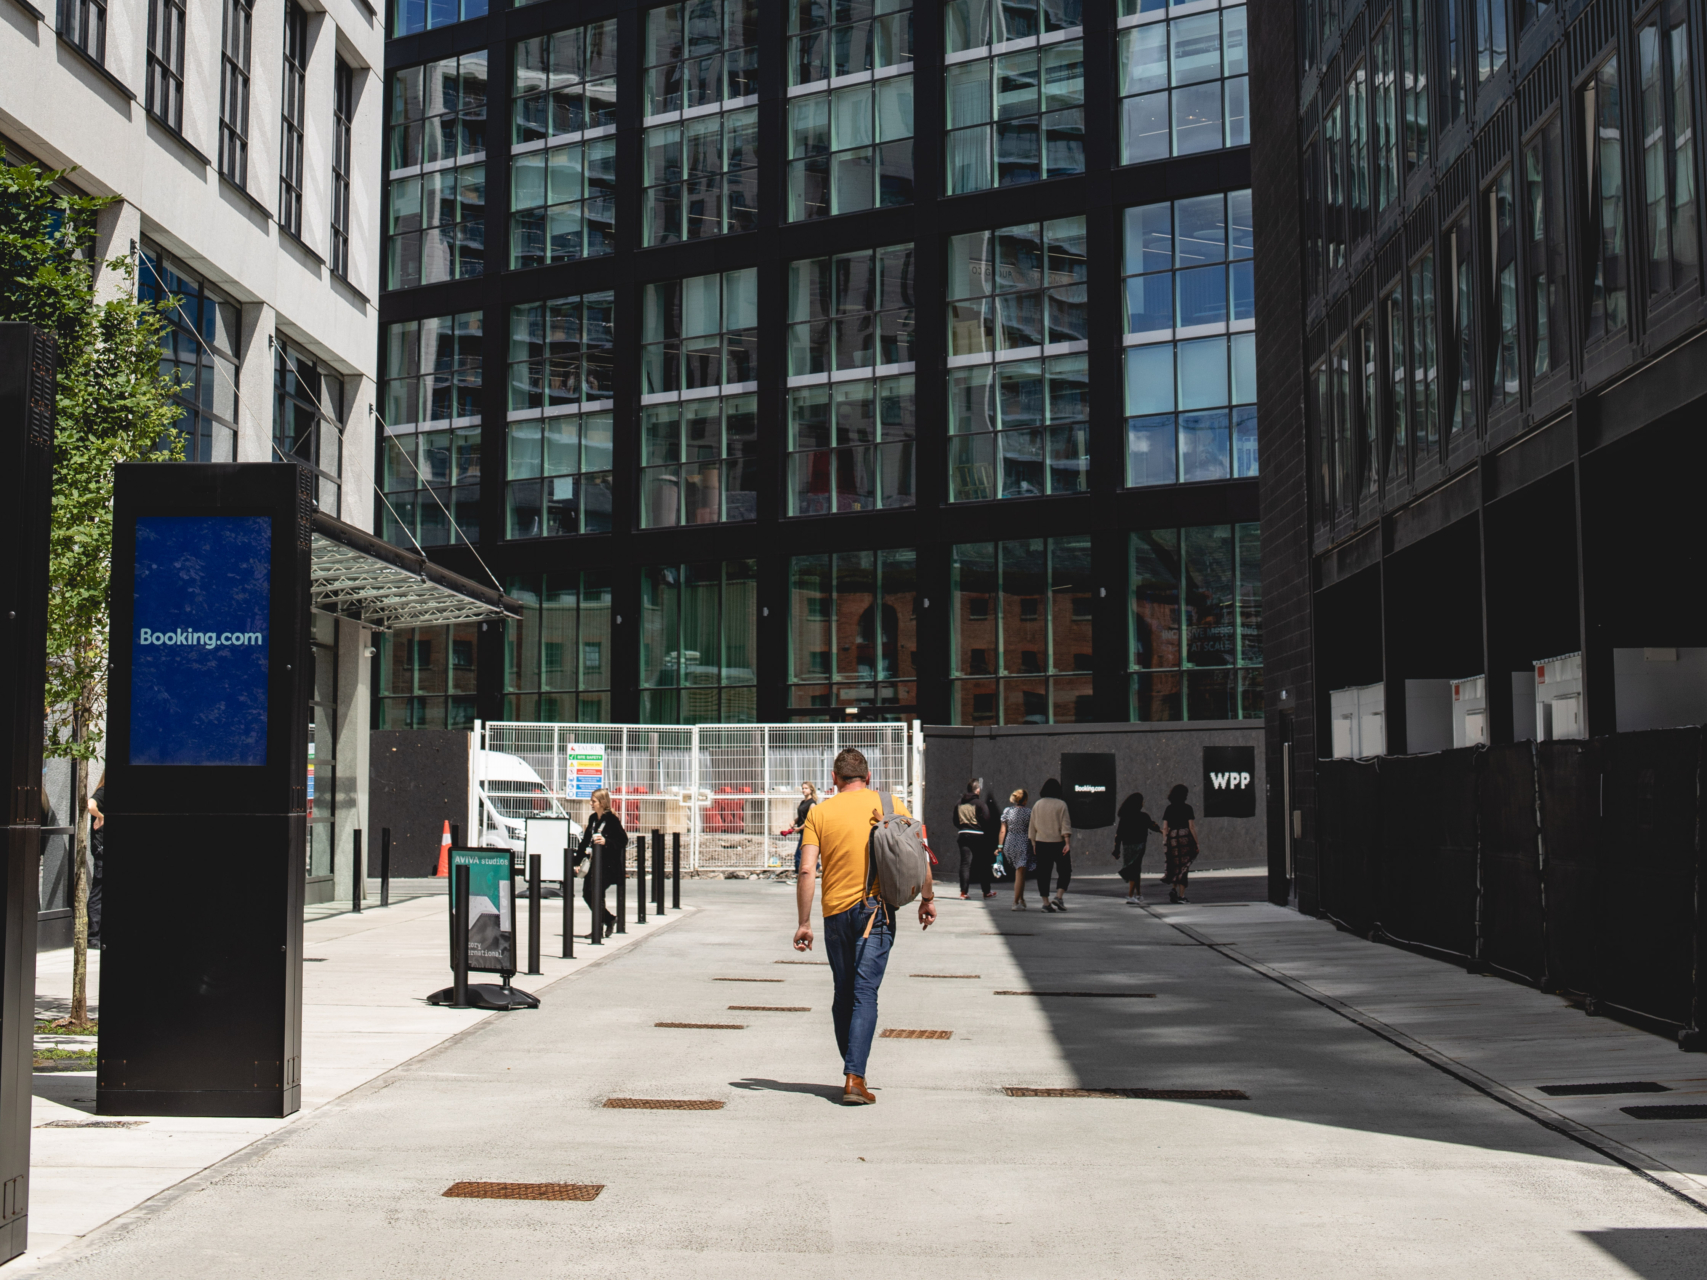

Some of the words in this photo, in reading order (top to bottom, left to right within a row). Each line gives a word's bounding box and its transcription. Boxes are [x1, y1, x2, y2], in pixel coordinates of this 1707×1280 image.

[985, 268, 1012, 278] GUP
[140, 628, 262, 649] Booking.com
[1209, 771, 1250, 790] WPP
[1075, 784, 1106, 793] Booking.com
[454, 855, 480, 865] AVIVA
[481, 858, 509, 866] studios
